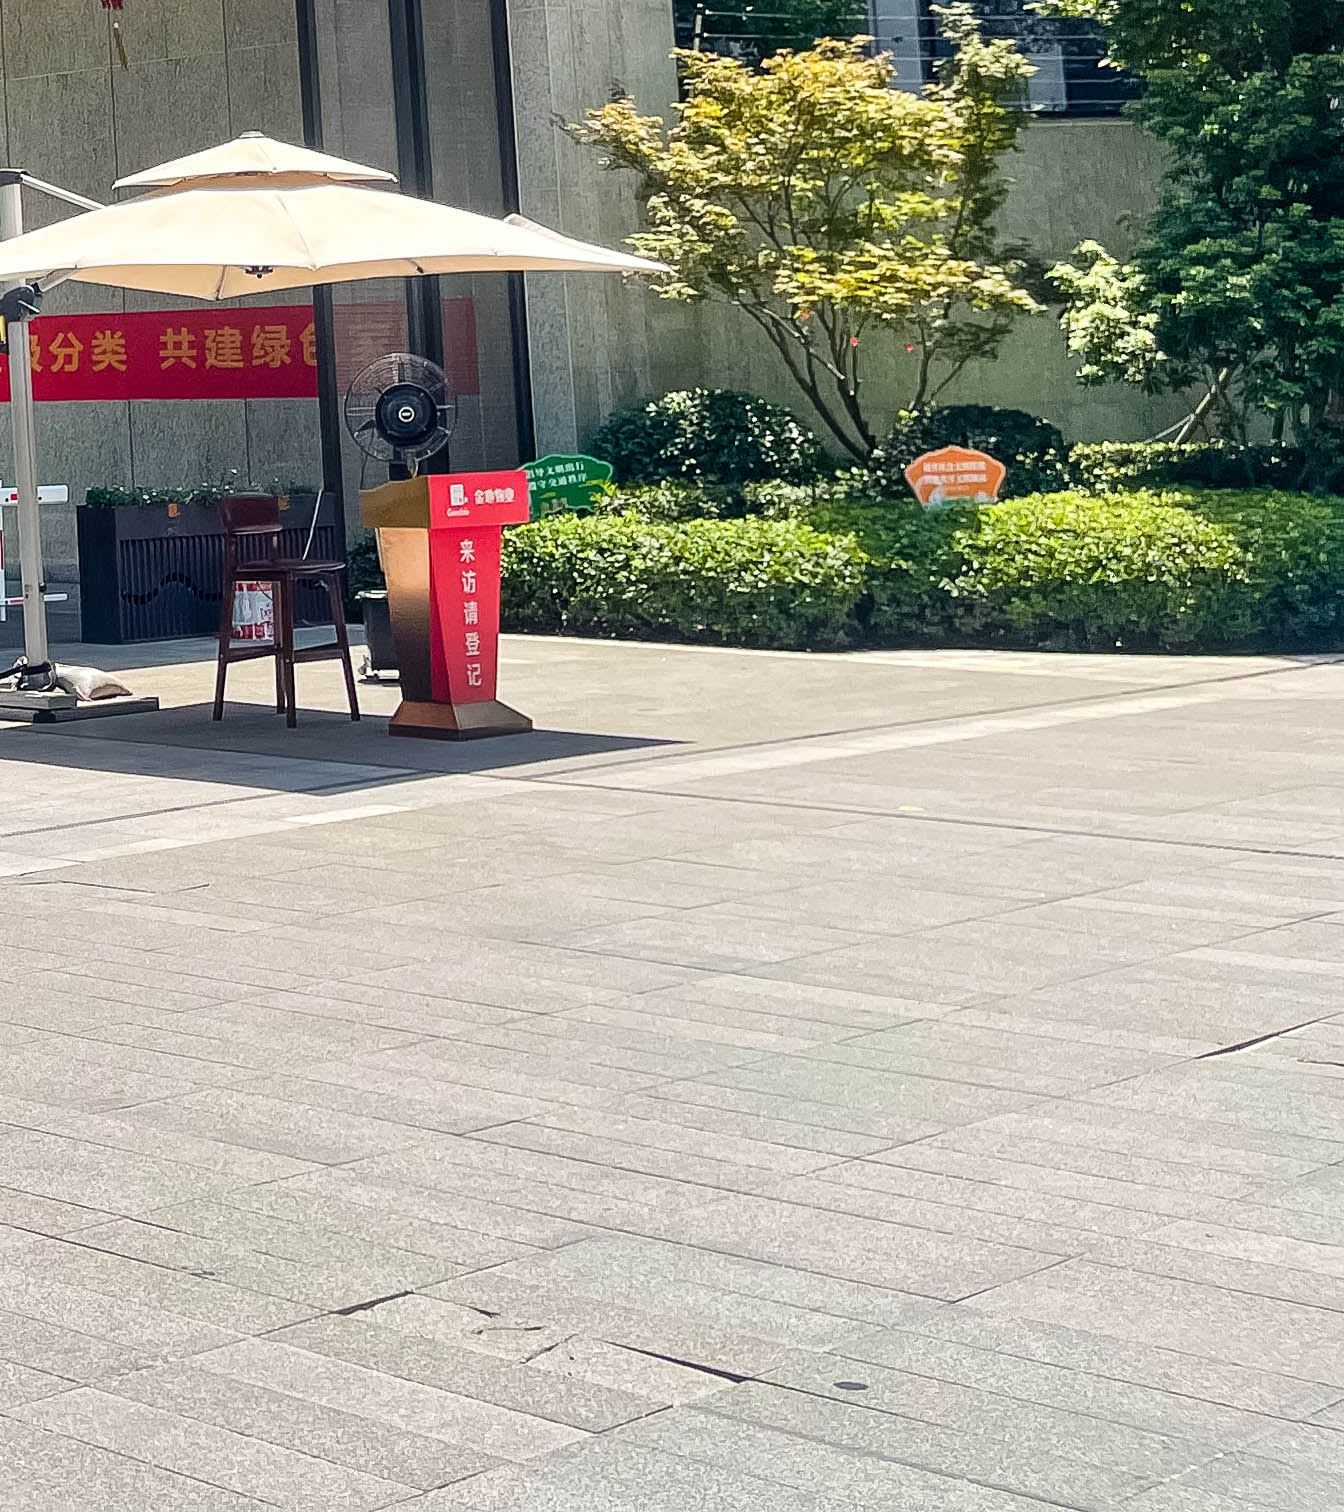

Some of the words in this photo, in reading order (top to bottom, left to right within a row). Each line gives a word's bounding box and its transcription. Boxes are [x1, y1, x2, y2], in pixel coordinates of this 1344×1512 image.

[459, 539, 482, 686] 来访请登记
